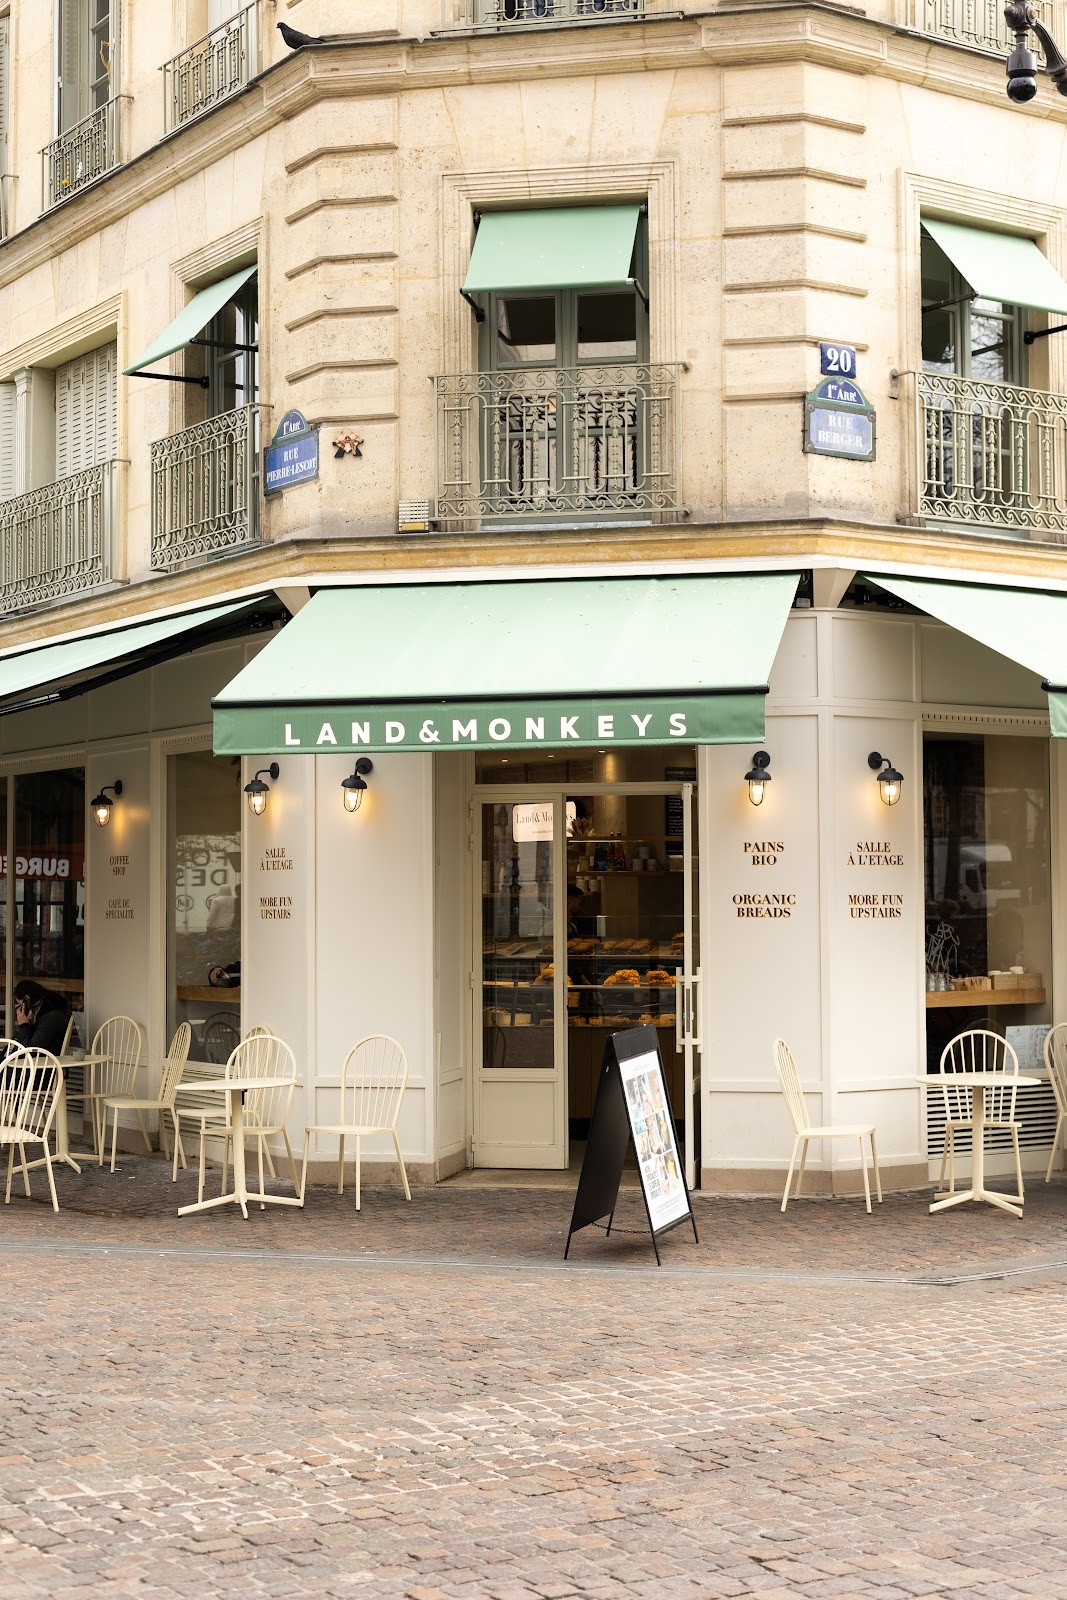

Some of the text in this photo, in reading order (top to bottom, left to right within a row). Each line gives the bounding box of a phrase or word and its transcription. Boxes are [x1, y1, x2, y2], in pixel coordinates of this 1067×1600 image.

[826, 347, 852, 373] 20
[828, 414, 854, 430] RUE
[817, 430, 863, 448] BERGER
[283, 447, 299, 463] RUE
[266, 458, 316, 482] PIERRE-LESCOT
[743, 842, 785, 852] PAINS
[856, 842, 891, 853] SALLE
[265, 848, 286, 858] SALLE
[751, 855, 777, 866] BIO
[847, 852, 855, 866] À
[260, 897, 292, 907] MORE FUN
[732, 894, 796, 905] ORGANIC
[848, 895, 903, 905] MORE FUN
[261, 909, 291, 919] UPSTAIRS
[736, 907, 791, 918] BREADS
[850, 907, 902, 918] UPSTAIRS
